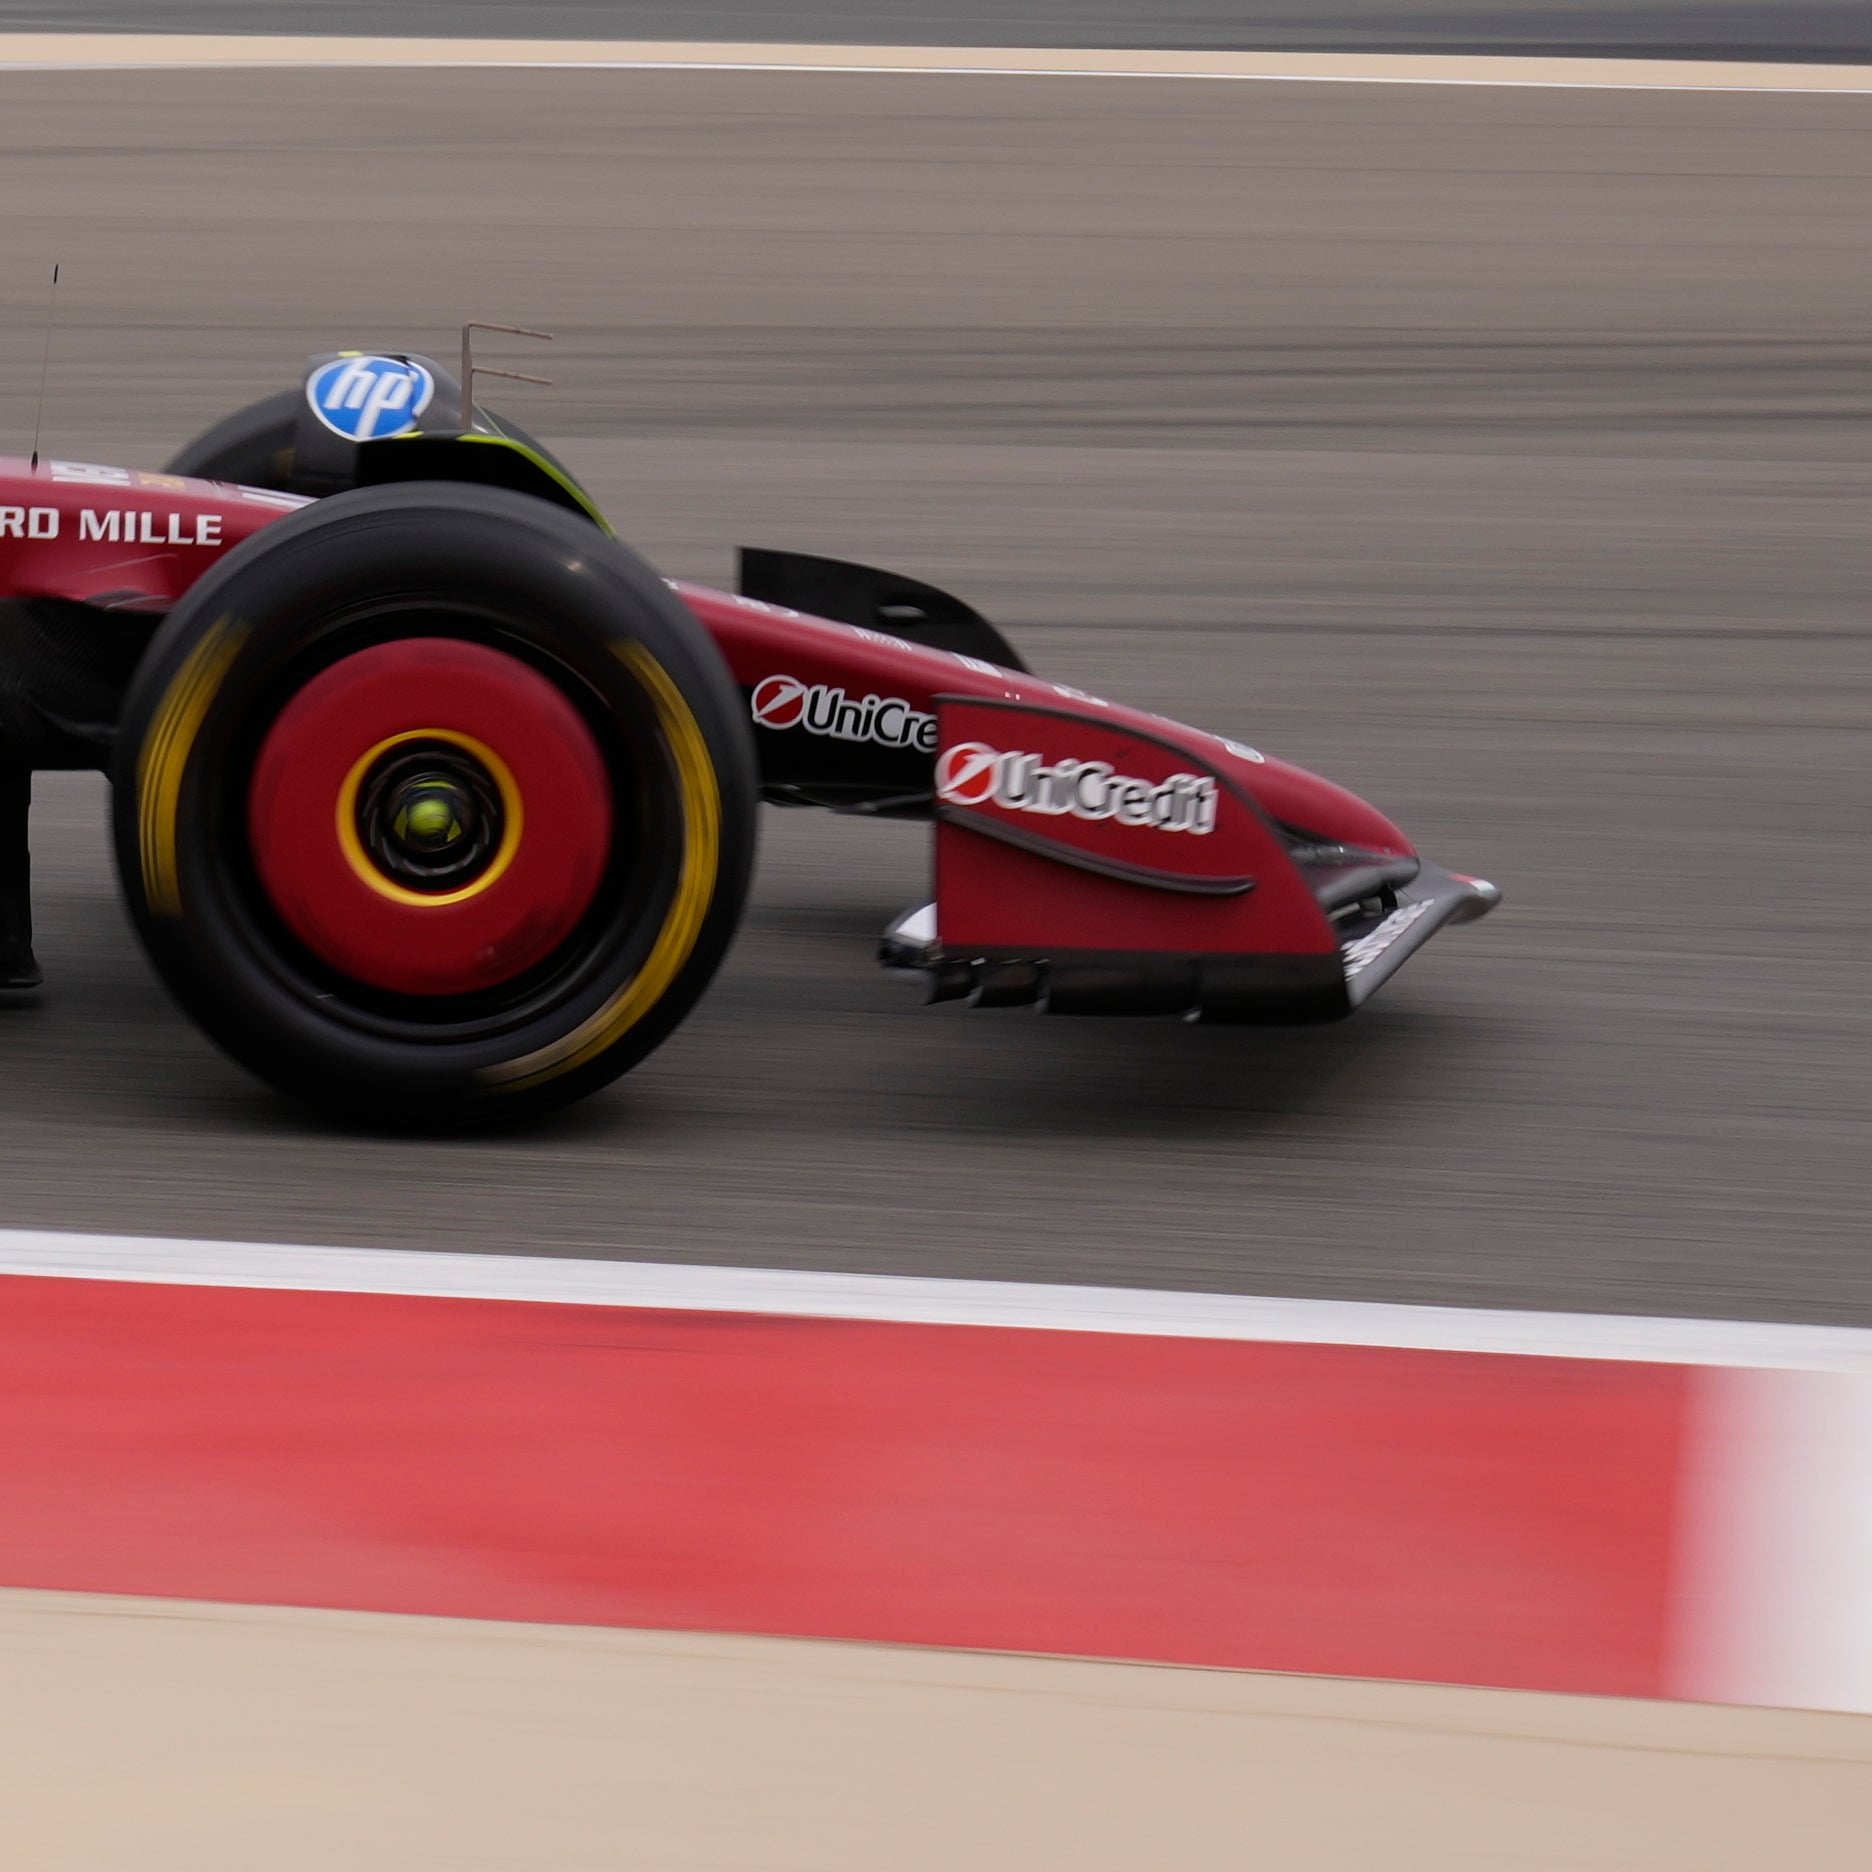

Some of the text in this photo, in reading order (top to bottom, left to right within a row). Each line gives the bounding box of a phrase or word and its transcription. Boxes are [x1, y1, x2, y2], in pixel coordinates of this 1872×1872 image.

[321, 357, 421, 441] hp
[78, 509, 223, 546] MILLE
[800, 684, 938, 753] UniCre
[994, 751, 1218, 835] UniCredit
